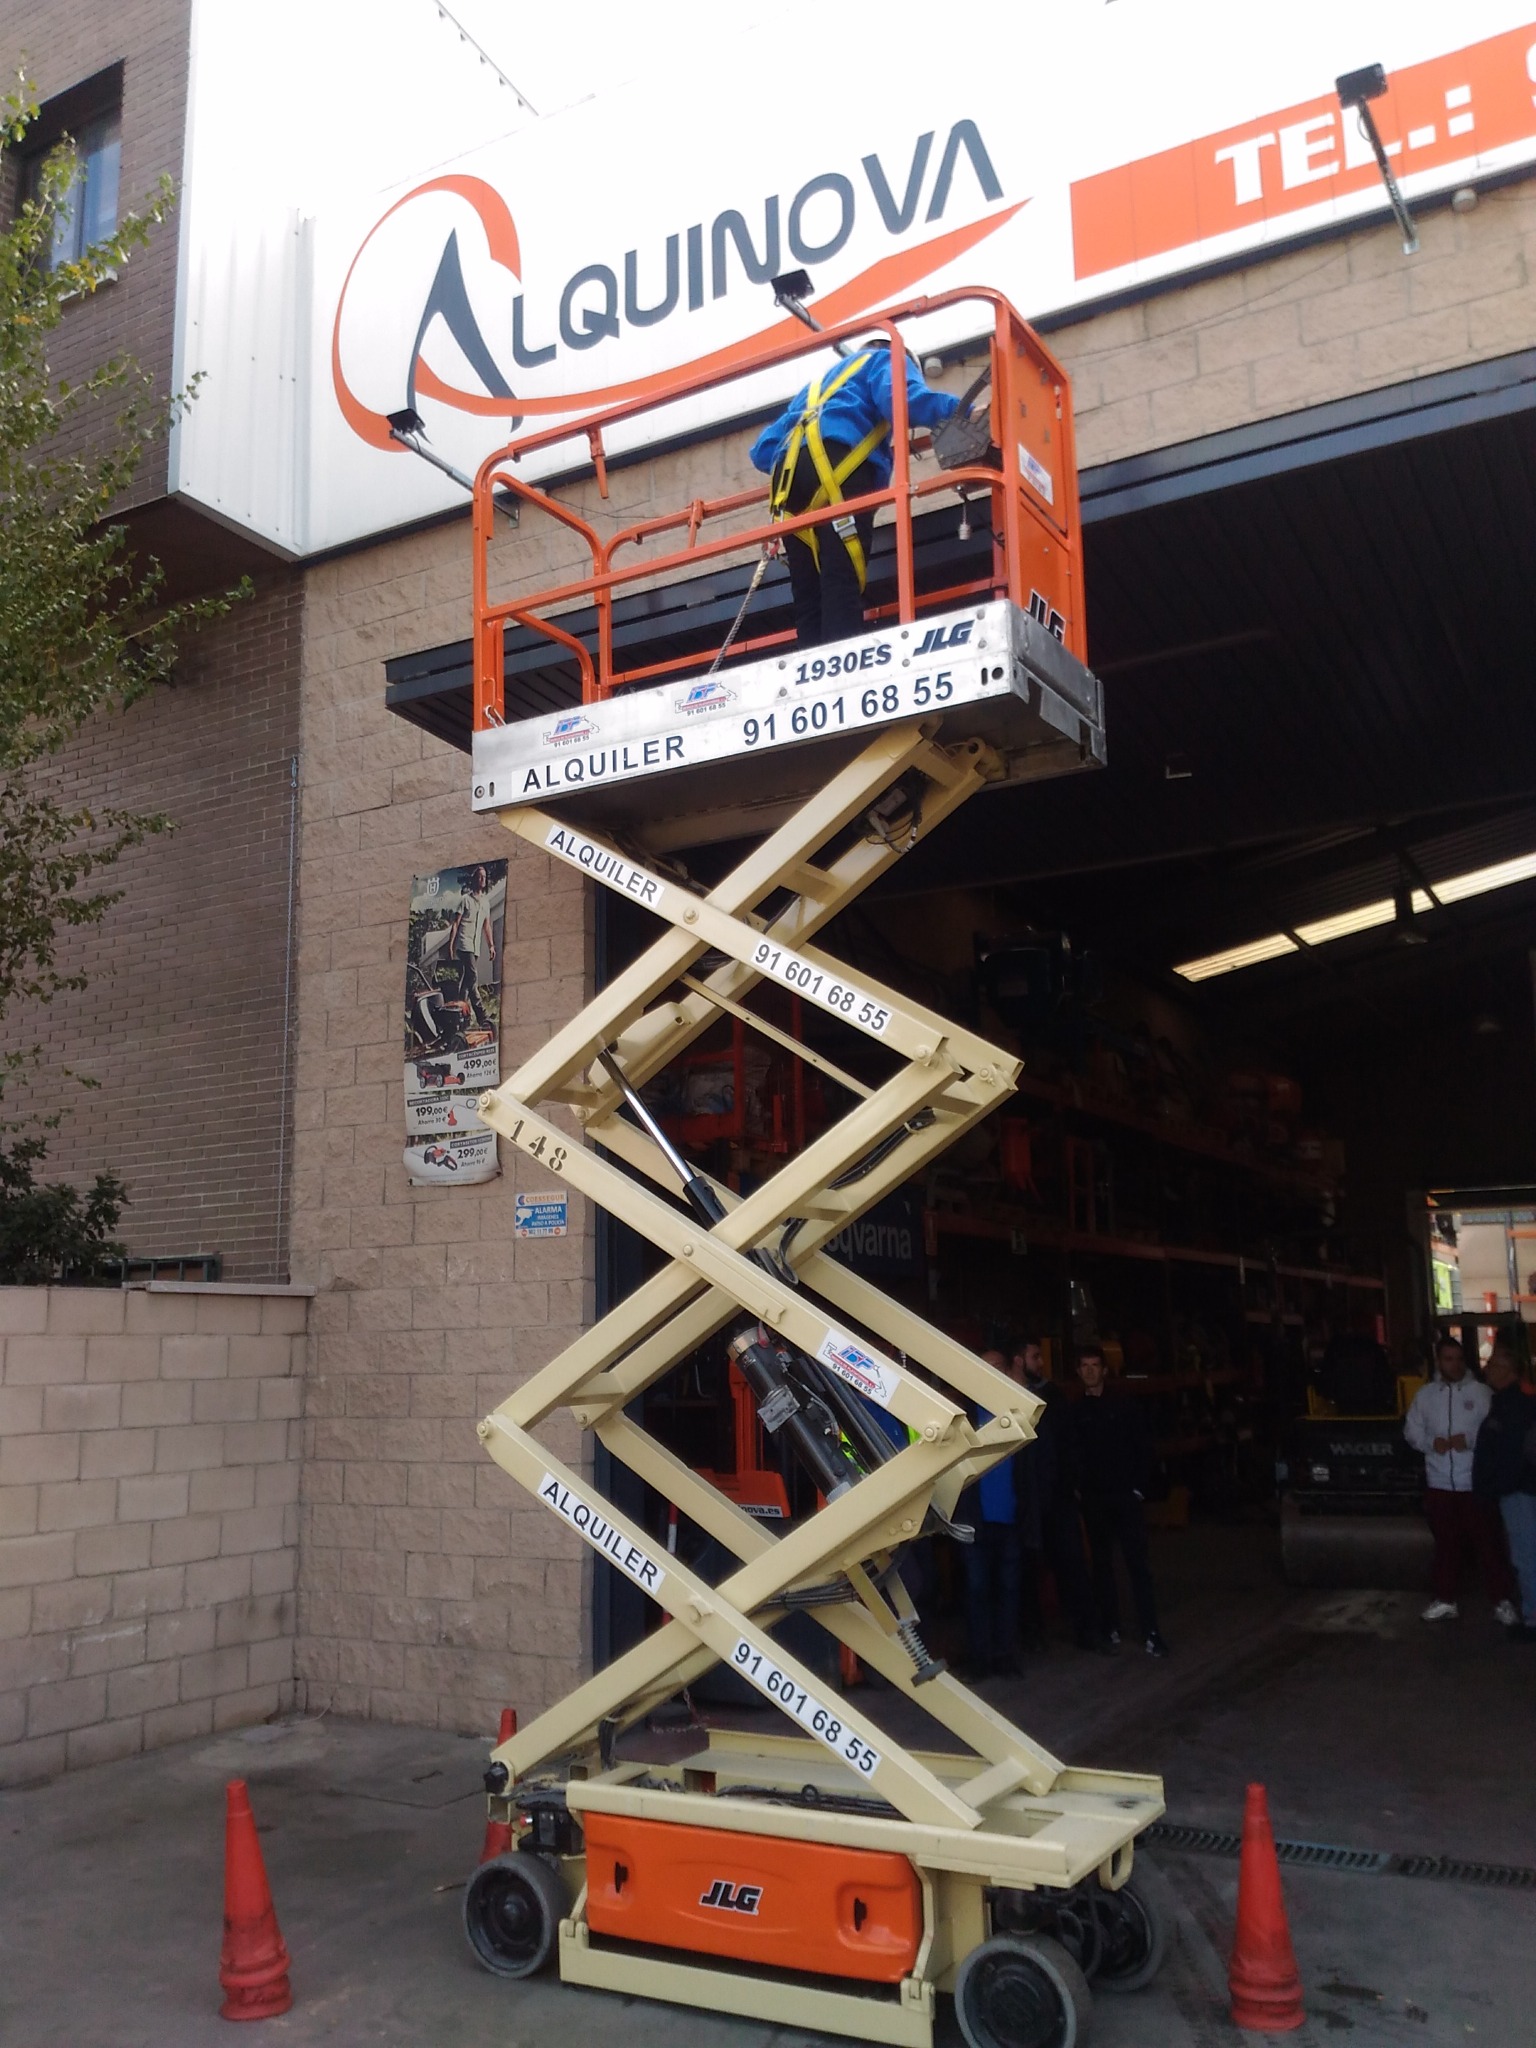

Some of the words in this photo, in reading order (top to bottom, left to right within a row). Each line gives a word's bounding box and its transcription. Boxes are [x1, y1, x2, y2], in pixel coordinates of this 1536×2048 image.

[406, 118, 1005, 442] ALQUINOVA
[1024, 589, 1067, 646] JLG
[795, 643, 892, 685] 1930ES
[912, 620, 976, 657] JLG
[522, 735, 685, 793] ALQUILER
[743, 713, 776, 746] 91
[791, 696, 845, 734] 601
[861, 684, 900, 718] 68
[913, 671, 953, 706] 55
[550, 830, 658, 903] ALQUILER
[755, 944, 781, 971] 91
[785, 961, 823, 995] 601
[827, 985, 855, 1012] 68
[858, 1002, 888, 1031] 55
[510, 1120, 568, 1172] 148
[535, 1205, 562, 1214] ALARMA
[832, 1363, 840, 1372] 91
[841, 1370, 853, 1381] 601
[854, 1379, 863, 1388] 68
[863, 1386, 872, 1395] 55
[542, 1481, 658, 1588] ALQUILER
[735, 1643, 763, 1675] 91
[767, 1671, 808, 1714] 601
[812, 1710, 841, 1742] 68
[845, 1737, 877, 1772] 55
[700, 1880, 763, 1914] JLG
